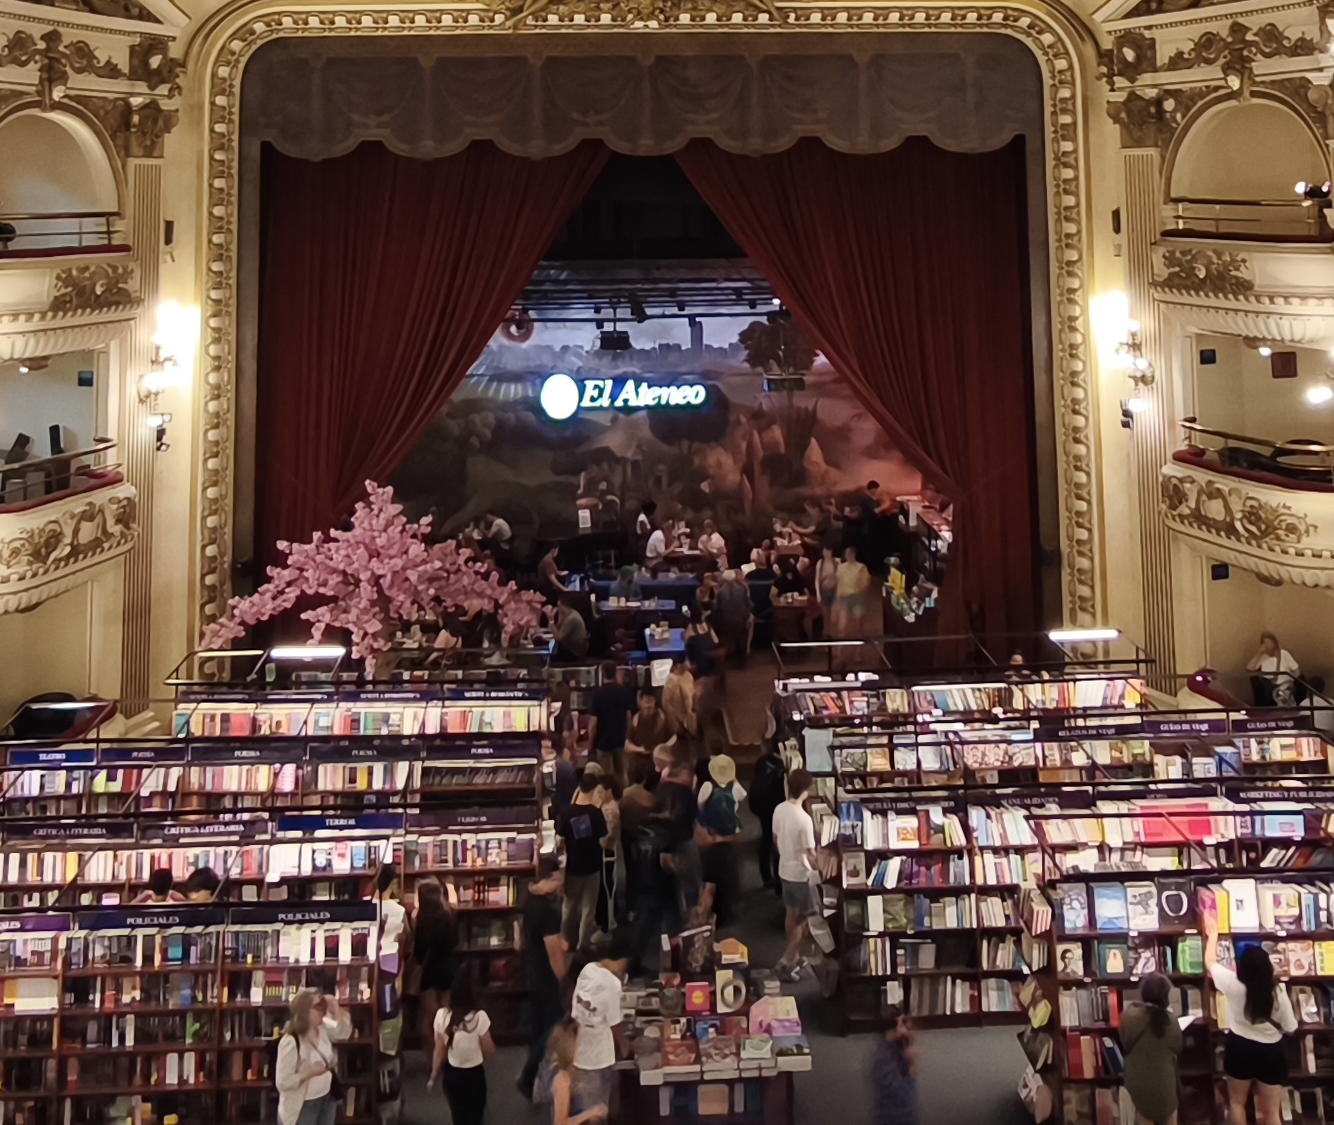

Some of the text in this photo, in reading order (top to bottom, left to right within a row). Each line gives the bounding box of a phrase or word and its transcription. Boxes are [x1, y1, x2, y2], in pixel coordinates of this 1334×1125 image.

[579, 378, 707, 407] El Ateneo
[126, 916, 180, 925] POLICIALES
[278, 911, 331, 921] POLICIALES
